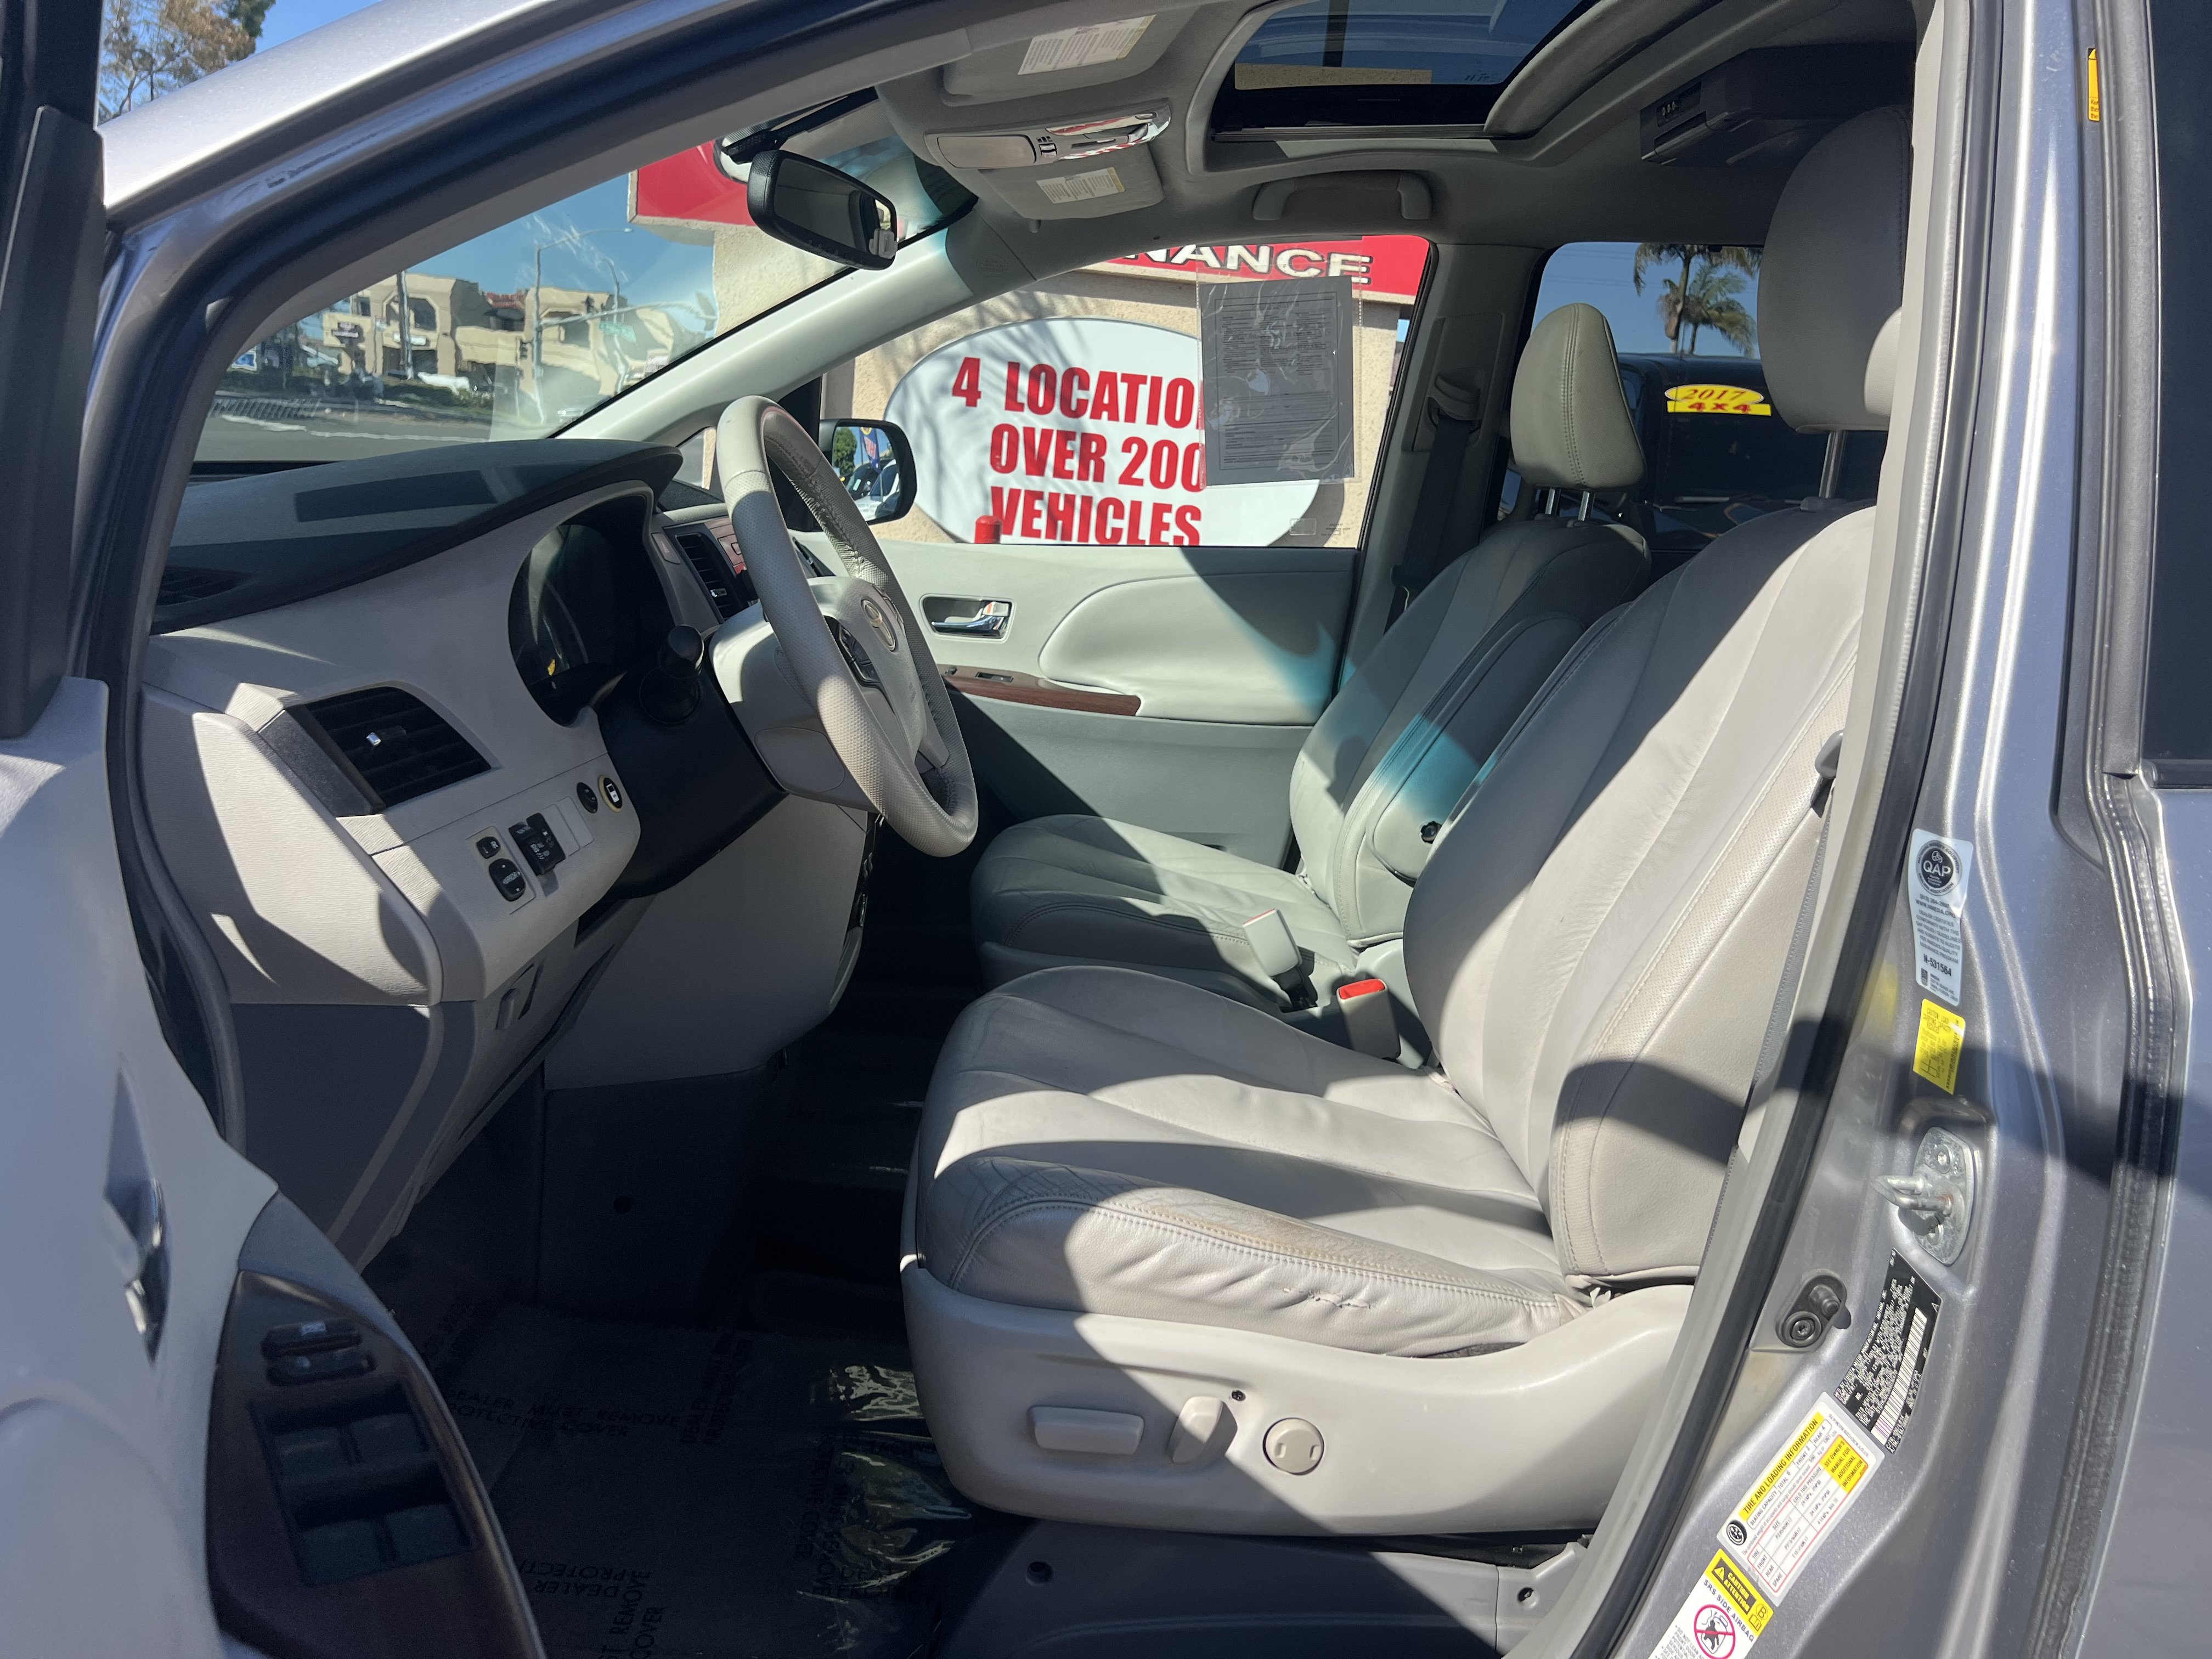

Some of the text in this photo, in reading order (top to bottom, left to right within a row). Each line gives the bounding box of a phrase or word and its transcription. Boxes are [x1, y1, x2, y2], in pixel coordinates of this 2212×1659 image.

[952, 357, 982, 408] 4
[1005, 361, 1204, 430] LOCATIO
[1682, 388, 1747, 402] 2017
[990, 423, 1108, 483] OVER
[991, 486, 1201, 546] VEHICLES
[1923, 860, 1951, 877] QAP
[449, 1401, 554, 1430] ROTECTIVE
[597, 1408, 681, 1426] REMOVE
[1830, 1441, 1845, 1460] OWNER'S
[1830, 1447, 1851, 1474] MANUAL FOR
[1743, 1419, 1818, 1514] TIRE AND LOADING INFORMATION
[1838, 1455, 1856, 1479] ADDITIONAL
[1842, 1460, 1863, 1488] INFORMATION
[1762, 1491, 1778, 1510] CAPACITY
[1778, 1477, 1788, 1489] TOTAL
[520, 1560, 627, 1582] PROTECTI
[1757, 1554, 1768, 1570] FRONT
[534, 1579, 620, 1598] DEALER
[1724, 1579, 1752, 1611] ATTENTION
[1728, 1572, 1750, 1599] CAUTION
[610, 1569, 651, 1635] REMOVE
[1703, 1579, 1754, 1642] SRS SIDE AIRBAG
[1756, 1606, 1768, 1620] B
